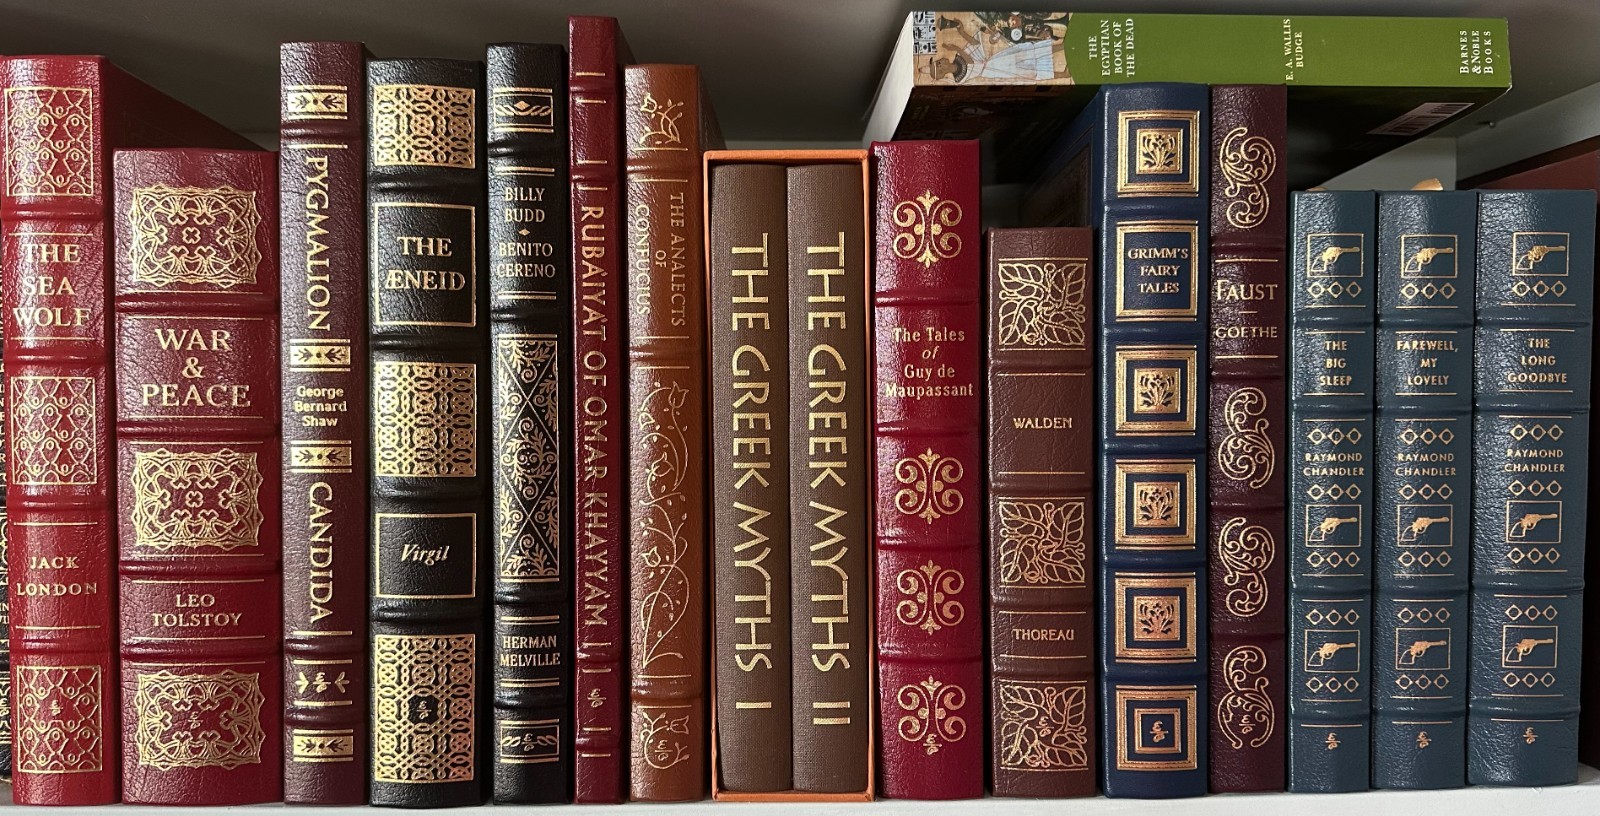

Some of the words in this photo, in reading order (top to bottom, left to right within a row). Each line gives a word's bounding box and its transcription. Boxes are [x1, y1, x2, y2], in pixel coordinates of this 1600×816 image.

[1113, 21, 1122, 37] OF
[1125, 18, 1134, 50] DEAD
[1283, 18, 1292, 56] WALLIS
[1088, 35, 1098, 60] THE
[1100, 19, 1111, 76] EGYPTIAN
[1295, 31, 1304, 68] BUDGE
[1459, 30, 1470, 74] BARNES
[1483, 31, 1494, 75] BOOKS
[1113, 40, 1123, 74] BOOK
[1285, 58, 1293, 69] A.
[1126, 53, 1135, 78] THE
[1285, 71, 1294, 81] E.
[504, 187, 546, 202] BILLY
[505, 208, 546, 224] BUDD
[670, 192, 685, 228] THE
[304, 154, 331, 332] PYGMALION
[396, 236, 453, 258] THE
[499, 243, 554, 259] BENITO
[24, 243, 80, 264] THE
[635, 204, 650, 316] CONFUCIUS
[655, 249, 667, 268] OF
[1127, 247, 1189, 260] GRIMM'S
[498, 264, 556, 279] CERENO
[1139, 265, 1181, 277] FAIRY
[22, 275, 76, 296] SEA
[384, 270, 466, 292] ÆNEID
[671, 233, 686, 327] ANALECTS
[731, 232, 771, 331] THE
[806, 231, 847, 331] THE
[1138, 282, 1180, 294] TALES
[12, 306, 91, 328] WOLF
[154, 328, 232, 351] WAR
[893, 327, 922, 342] The
[926, 327, 966, 342] Tales
[1215, 326, 1278, 340] GOETHE
[1324, 340, 1348, 351] THE
[1396, 340, 1458, 353] FAREWELL,
[1527, 338, 1551, 349] THE
[921, 344, 940, 360] of
[181, 356, 204, 379] &
[583, 350, 607, 387] OF
[1325, 358, 1347, 369] BIG
[1420, 357, 1438, 368] MY
[1521, 355, 1557, 367] LONG
[904, 364, 932, 382] Guy
[937, 364, 956, 379] de
[1320, 375, 1353, 387] SLEEP
[1407, 375, 1450, 386] LOVELY
[1507, 372, 1568, 384] GOODBYE
[140, 383, 251, 408] PEACE
[296, 385, 345, 400] George
[885, 382, 974, 400] Maupassant
[293, 400, 348, 413] Bernard
[302, 415, 338, 428] Shaw
[731, 344, 772, 489] GREEK
[808, 344, 848, 489] GREEK
[1013, 416, 1073, 430] WALDEN
[583, 396, 608, 482] OMAR
[1304, 452, 1363, 463] RAYMOND
[1397, 452, 1455, 463] RAYMOND
[1506, 448, 1564, 459] RAYMOND
[1303, 466, 1365, 477] CHANDLER
[1394, 466, 1457, 477] CHANDLER
[1503, 463, 1566, 474] CHANDLER
[308, 480, 334, 623] CANDIDA
[401, 543, 450, 567] Virgil
[29, 554, 79, 569] JACK
[16, 581, 97, 596] LONDON
[733, 500, 773, 673] MYTHS
[809, 500, 850, 673] MYTHS
[176, 594, 215, 608] LEO
[152, 612, 242, 628] TOLSTOY
[502, 635, 558, 650] HERMAN
[1013, 628, 1075, 642] THOREAU
[500, 651, 562, 668] MELVILLE
[735, 701, 772, 709] I
[812, 701, 851, 725] II
